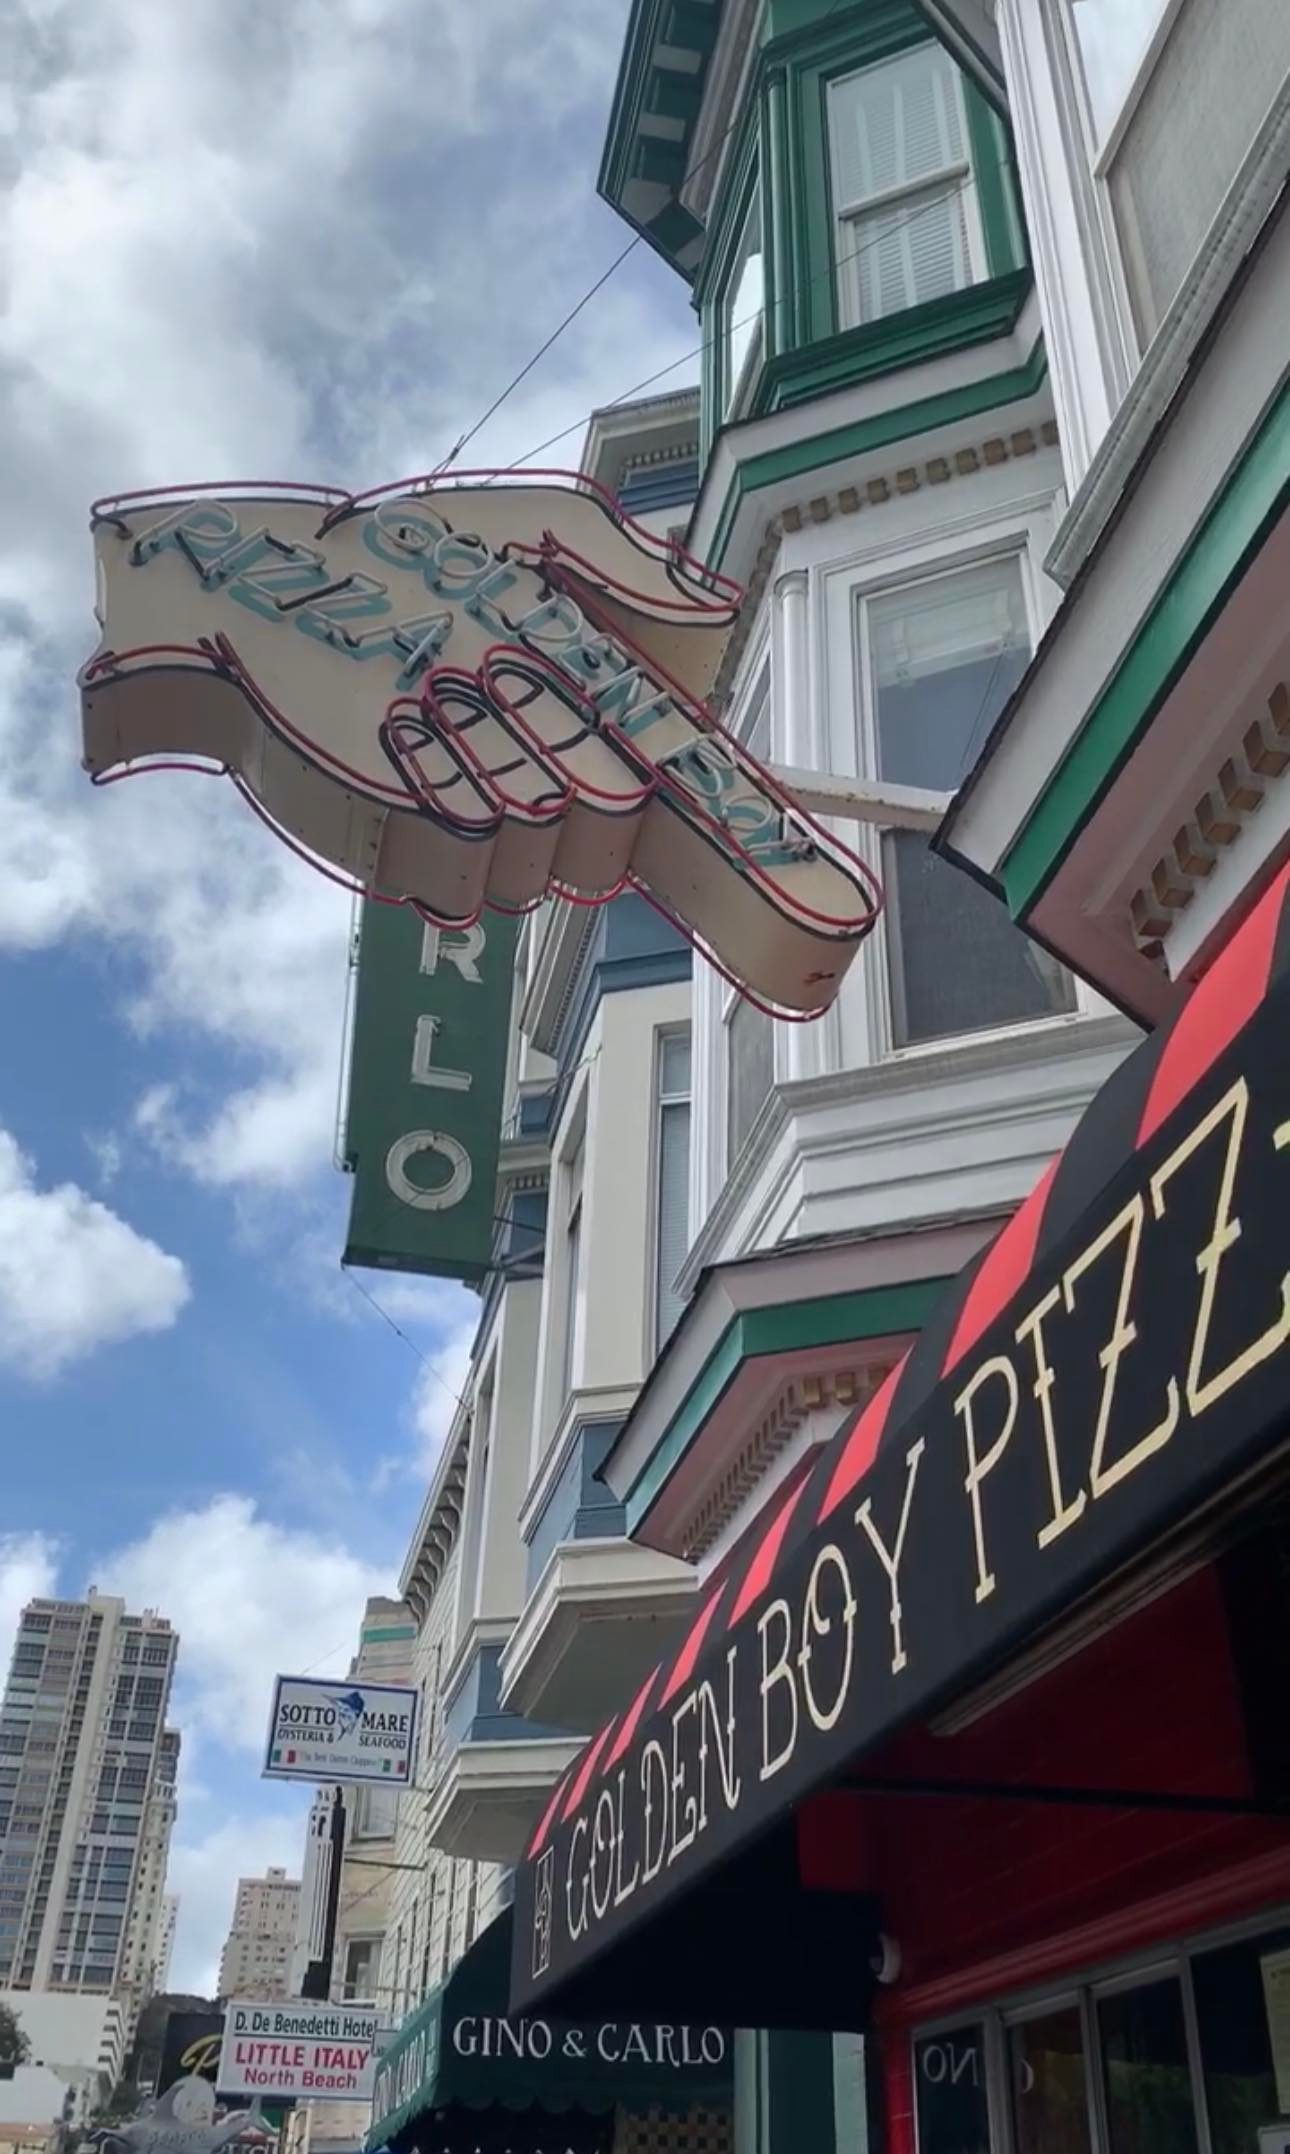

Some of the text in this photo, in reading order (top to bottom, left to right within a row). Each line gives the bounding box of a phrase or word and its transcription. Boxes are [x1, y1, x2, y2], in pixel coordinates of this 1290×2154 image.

[130, 499, 454, 692] PIZZA
[364, 498, 817, 869] GOLDEN BOY
[565, 1074, 1290, 1941] GOLDEN BOY PIZZ
[279, 1703, 409, 1733] SOTTO MARE
[358, 1734, 407, 1750] SEAFOOD
[235, 2011, 378, 2038] D. De Benedetti Hotel
[235, 2043, 305, 2067] LITTLE
[314, 2047, 370, 2070] ITALY
[453, 2016, 725, 2068] GINO & CARLO
[244, 2069, 357, 2089] North Beach
